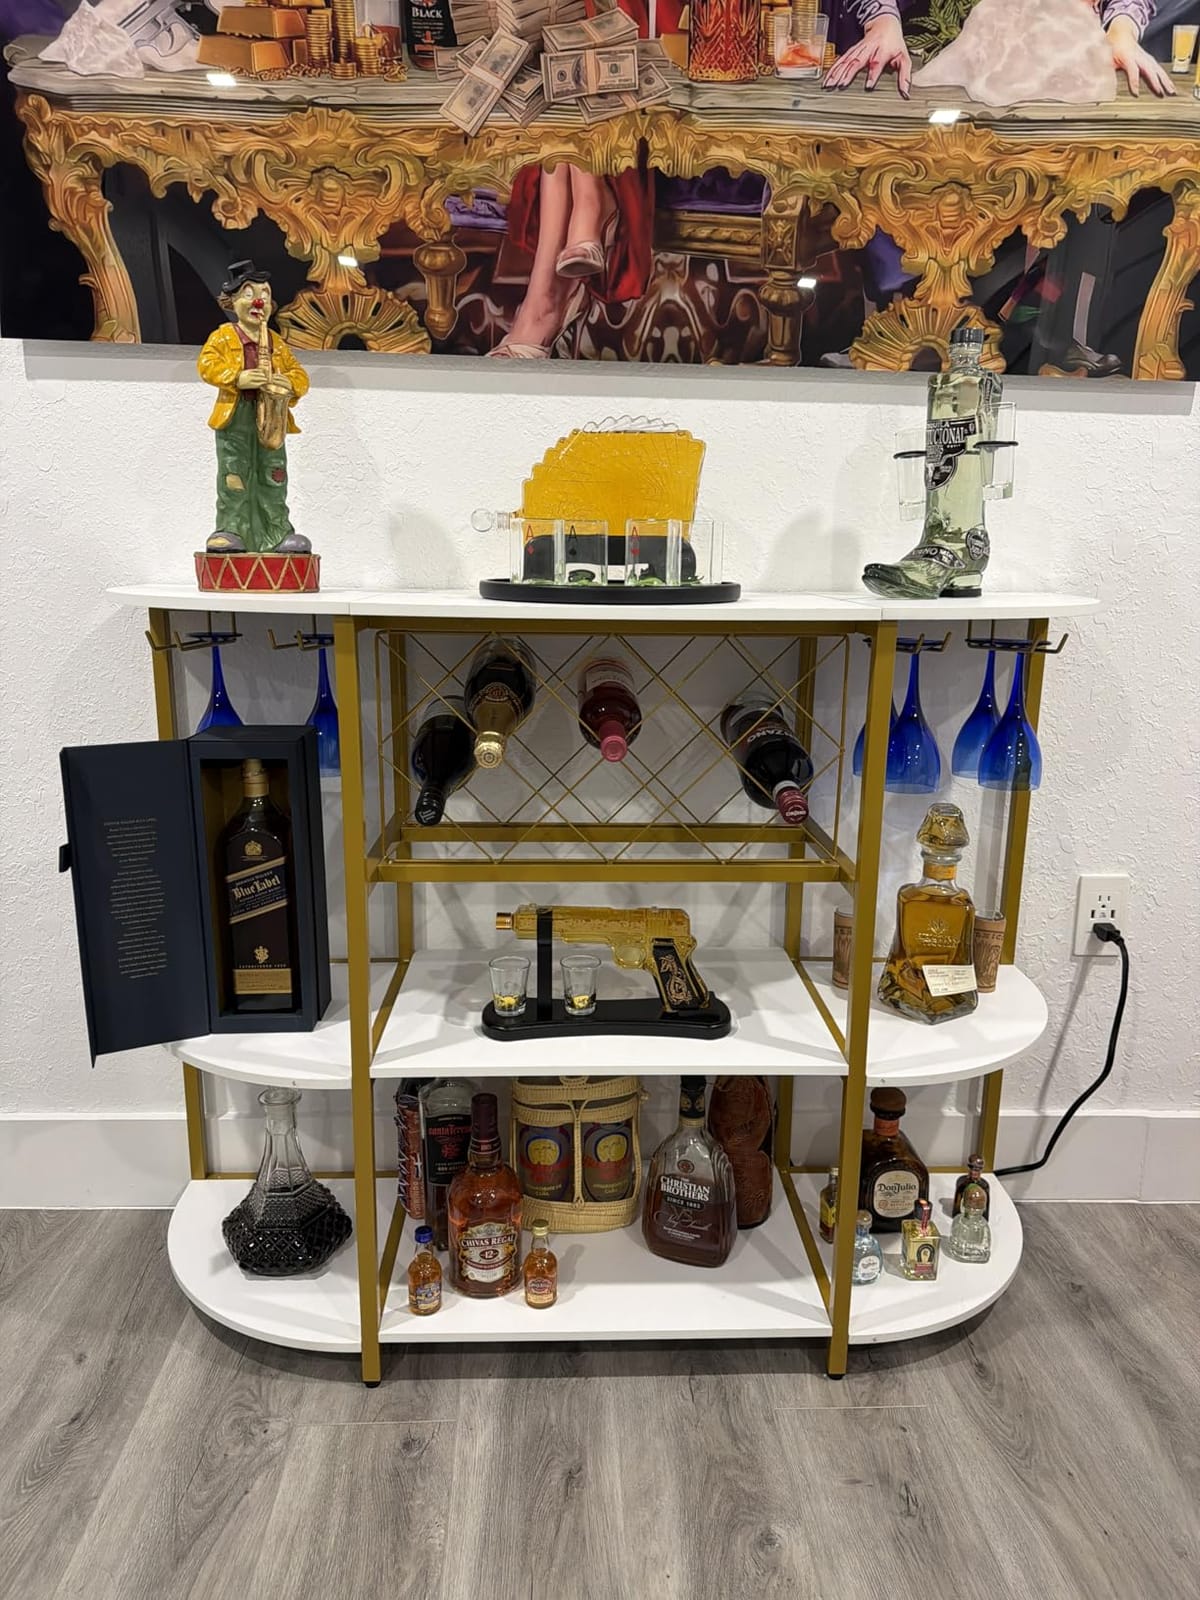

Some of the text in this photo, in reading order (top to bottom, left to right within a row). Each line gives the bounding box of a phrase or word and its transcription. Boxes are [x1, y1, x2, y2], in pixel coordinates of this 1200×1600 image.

[411, 7, 442, 18] BLACK
[232, 885, 255, 901] Blue
[253, 874, 281, 893] Label
[660, 1176, 710, 1194] CHRISTIAN
[877, 1183, 916, 1193] Don Julio
[660, 1183, 709, 1202] BROTHERS
[461, 1238, 490, 1247] CHIVAS
[485, 1250, 494, 1259] 12
